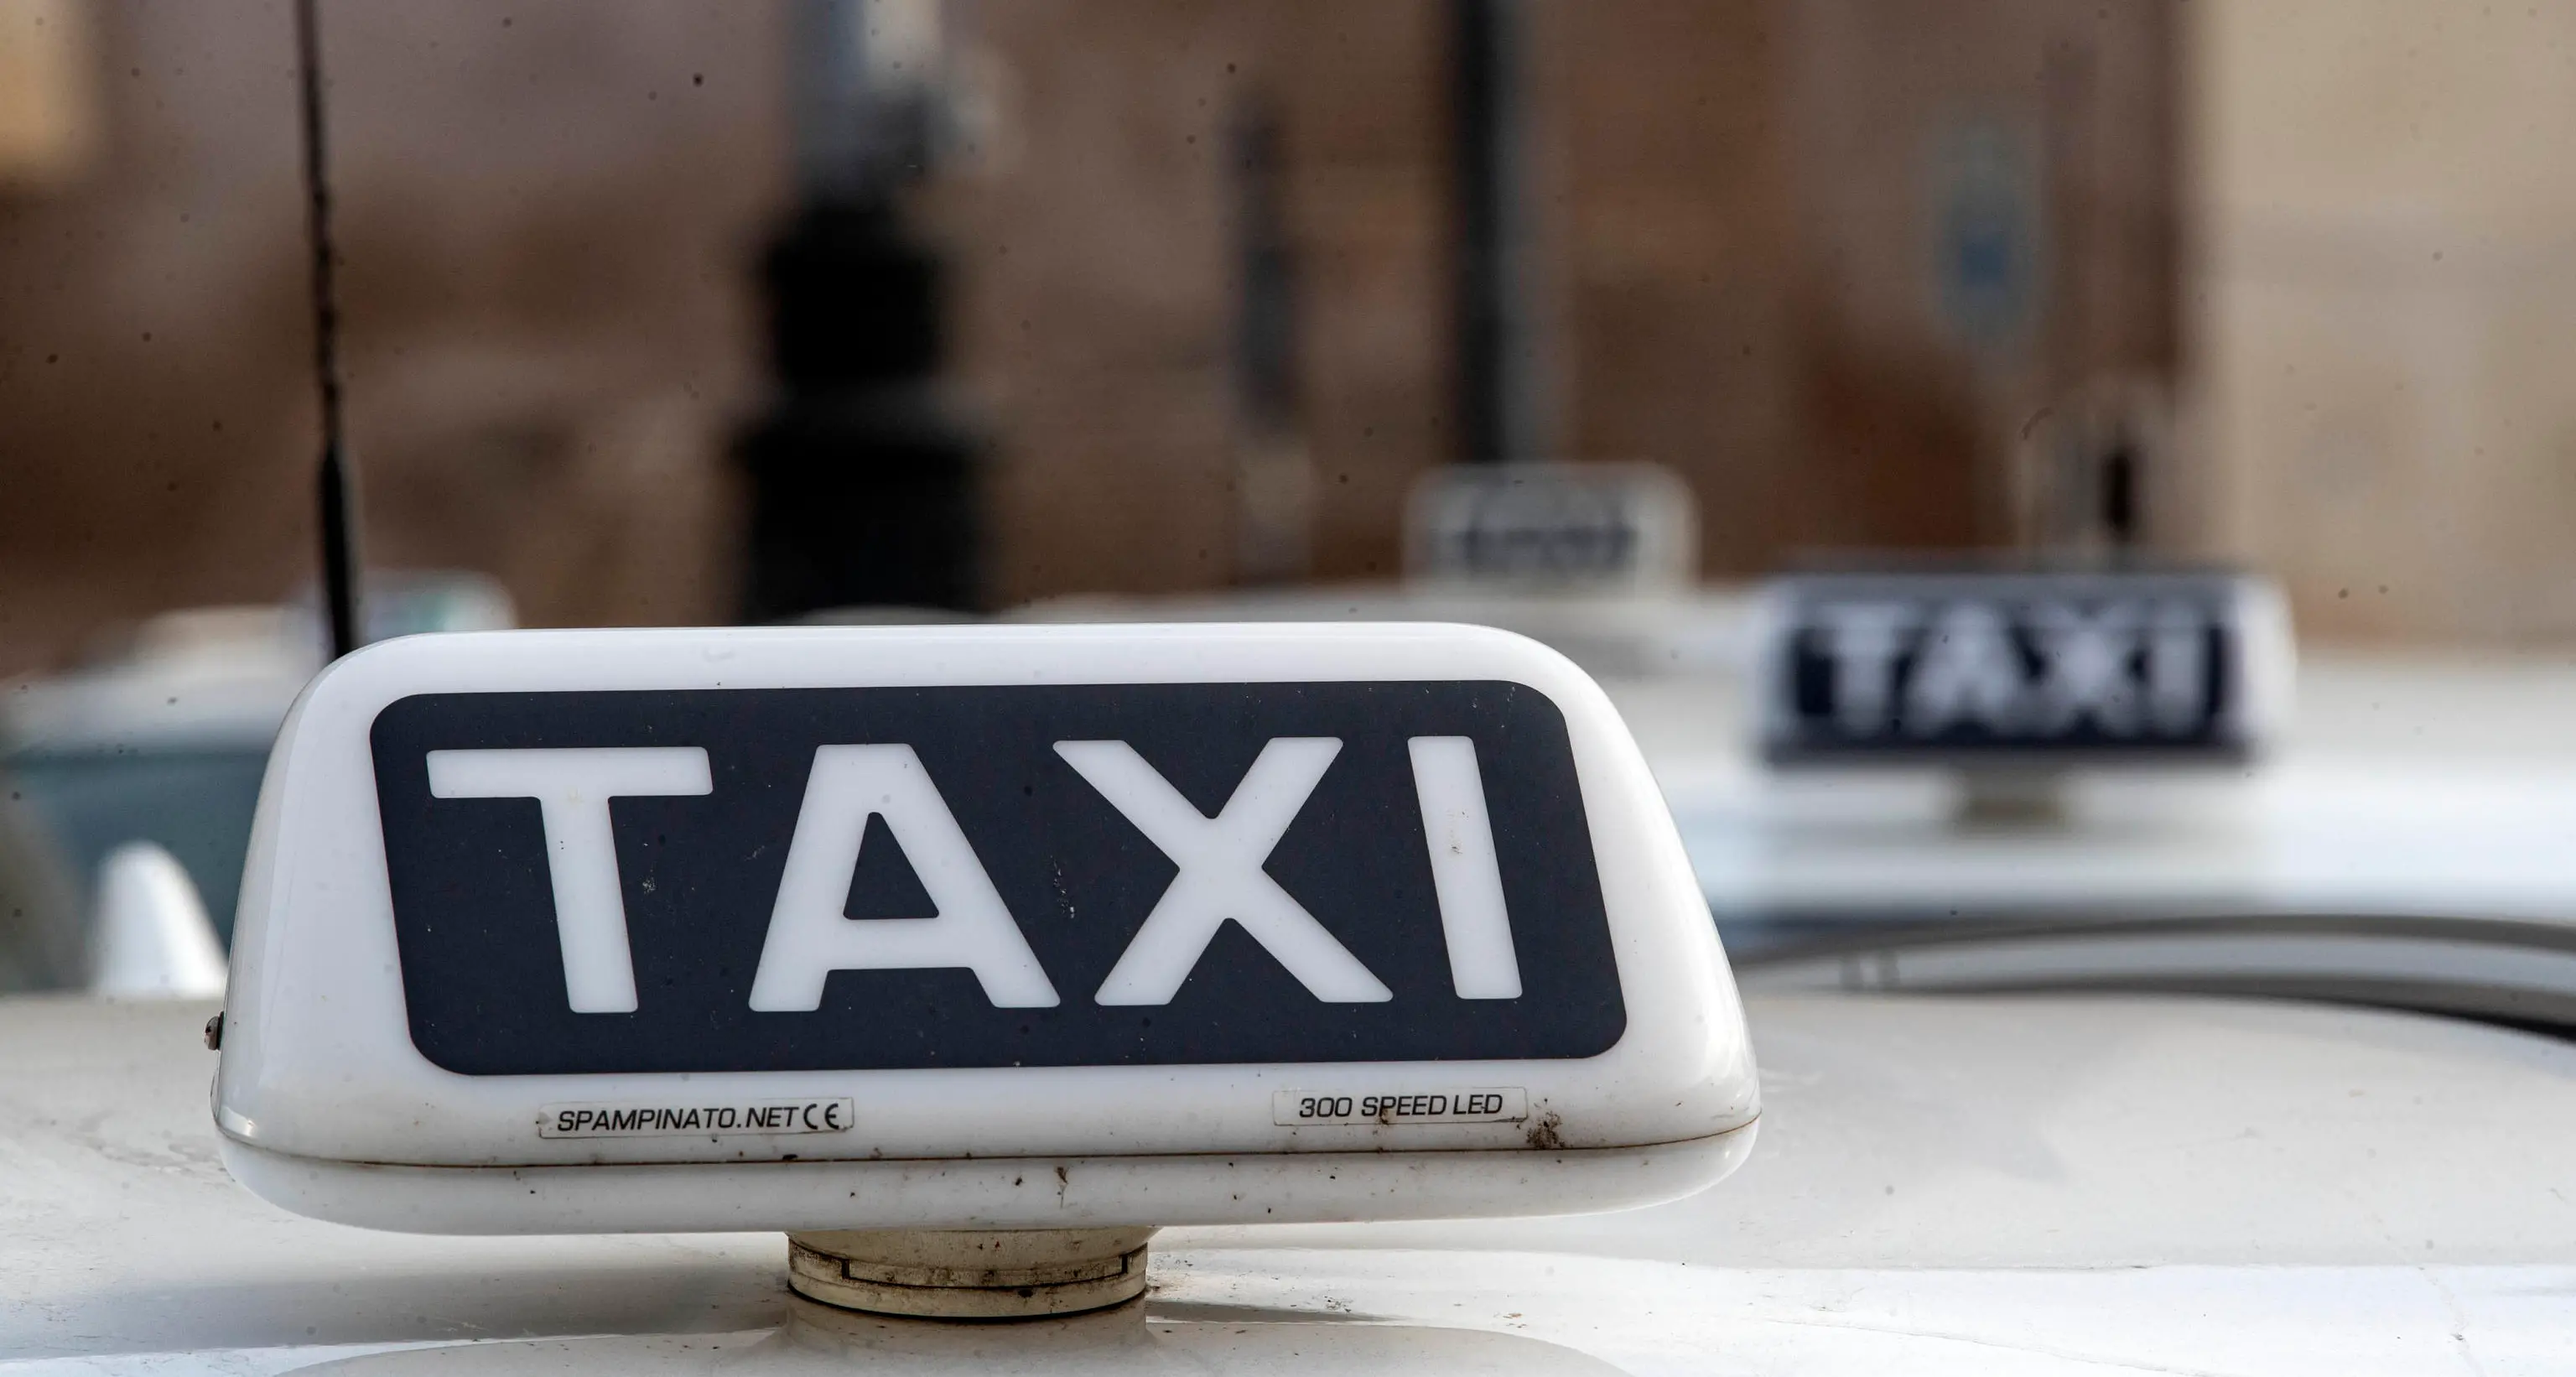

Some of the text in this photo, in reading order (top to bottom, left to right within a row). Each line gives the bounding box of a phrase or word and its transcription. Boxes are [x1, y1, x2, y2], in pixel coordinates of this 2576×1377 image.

[1824, 597, 2210, 743] TAXI
[426, 735, 1523, 1013] TAXI
[558, 1107, 799, 1131] SPAMPINATO.NET
[1299, 1094, 1504, 1118] 300 SPEED LED
